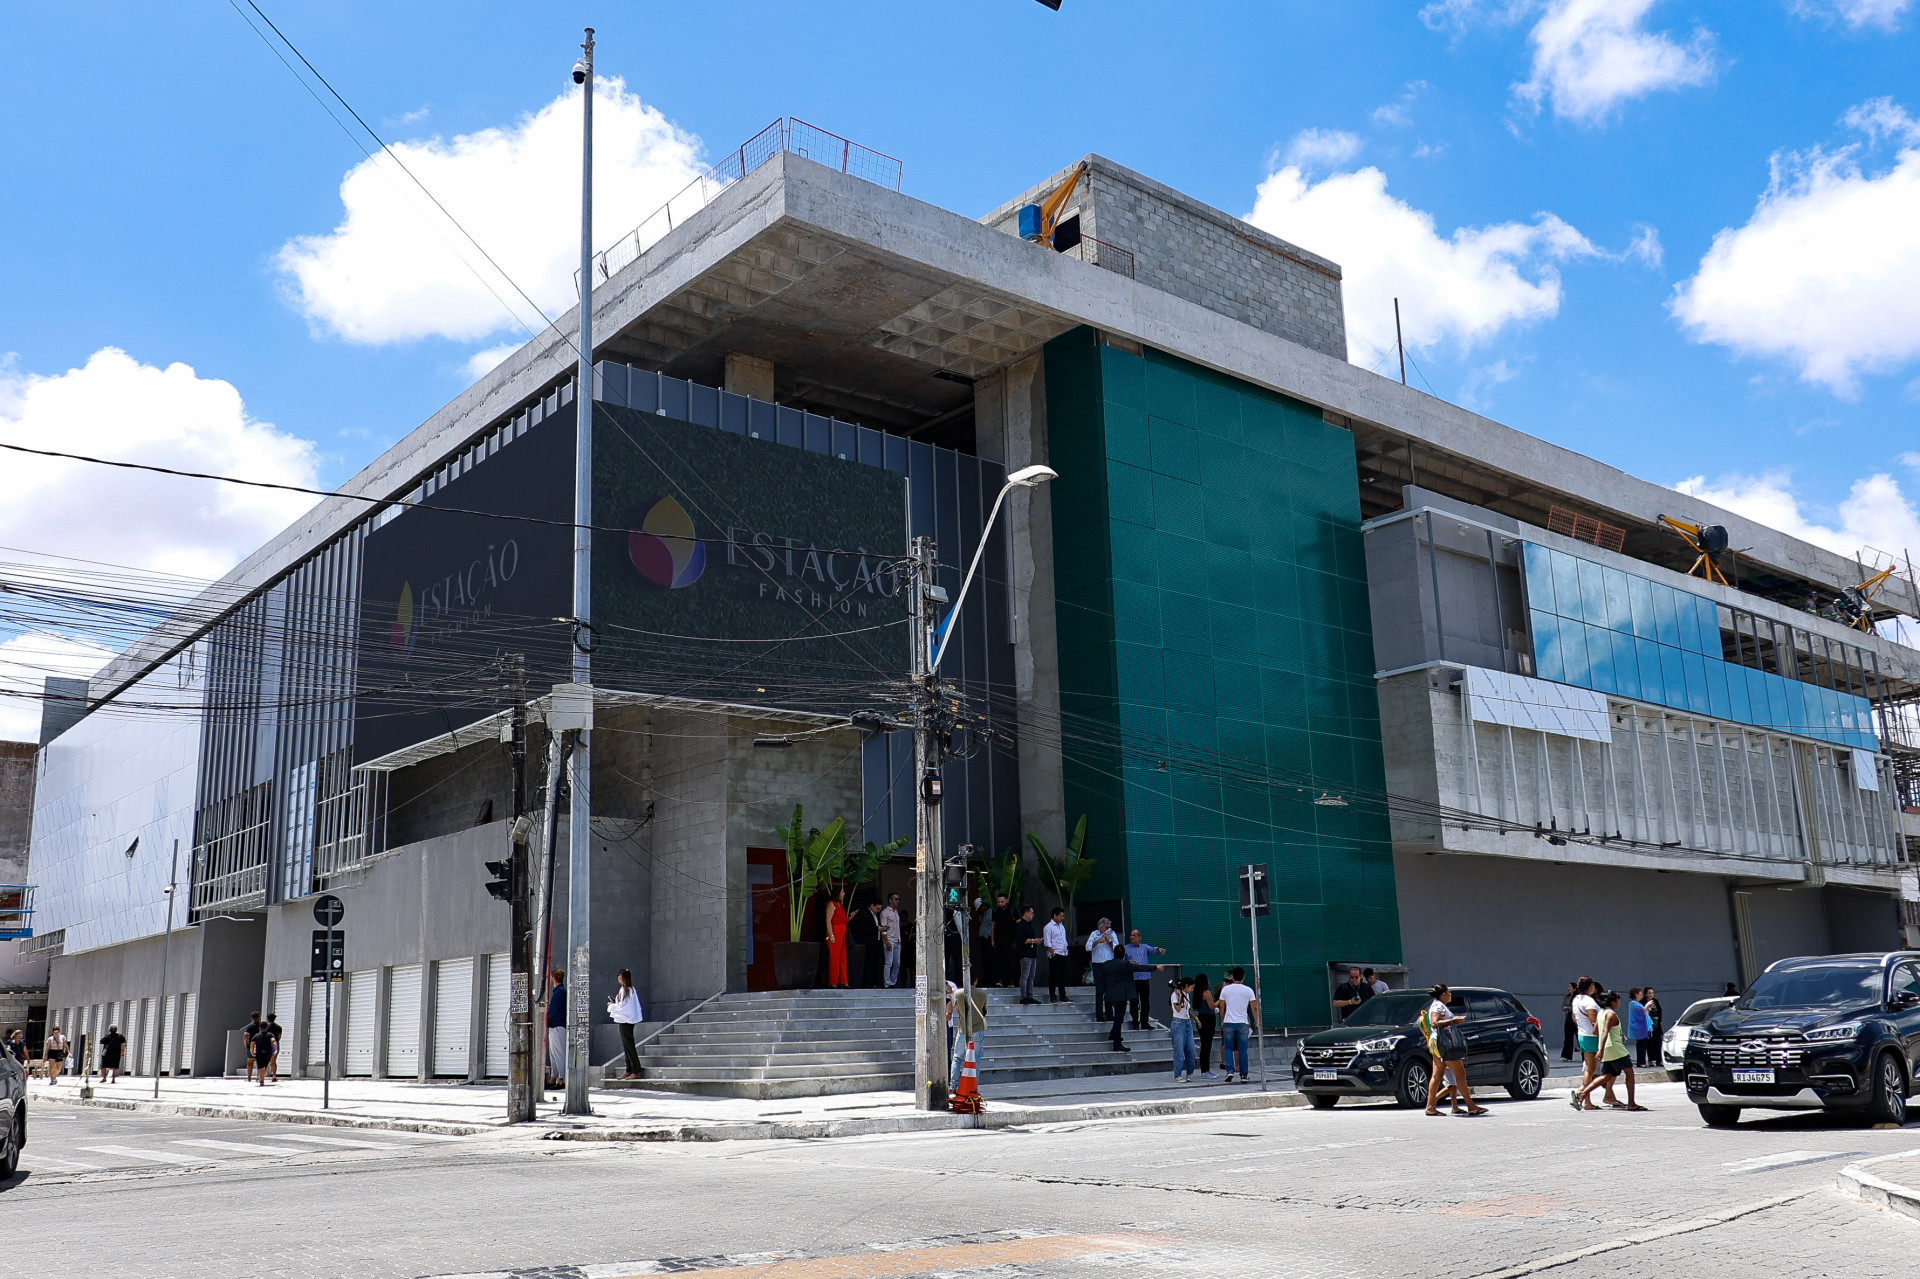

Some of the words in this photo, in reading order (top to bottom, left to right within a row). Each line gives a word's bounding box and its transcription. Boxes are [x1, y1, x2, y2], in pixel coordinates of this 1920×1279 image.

[420, 538, 519, 626] ESTAÇÃO
[727, 525, 898, 598] ESTAÇÃO
[759, 583, 867, 618] FASHION
[1736, 1073, 1771, 1082] RIJ4G75
